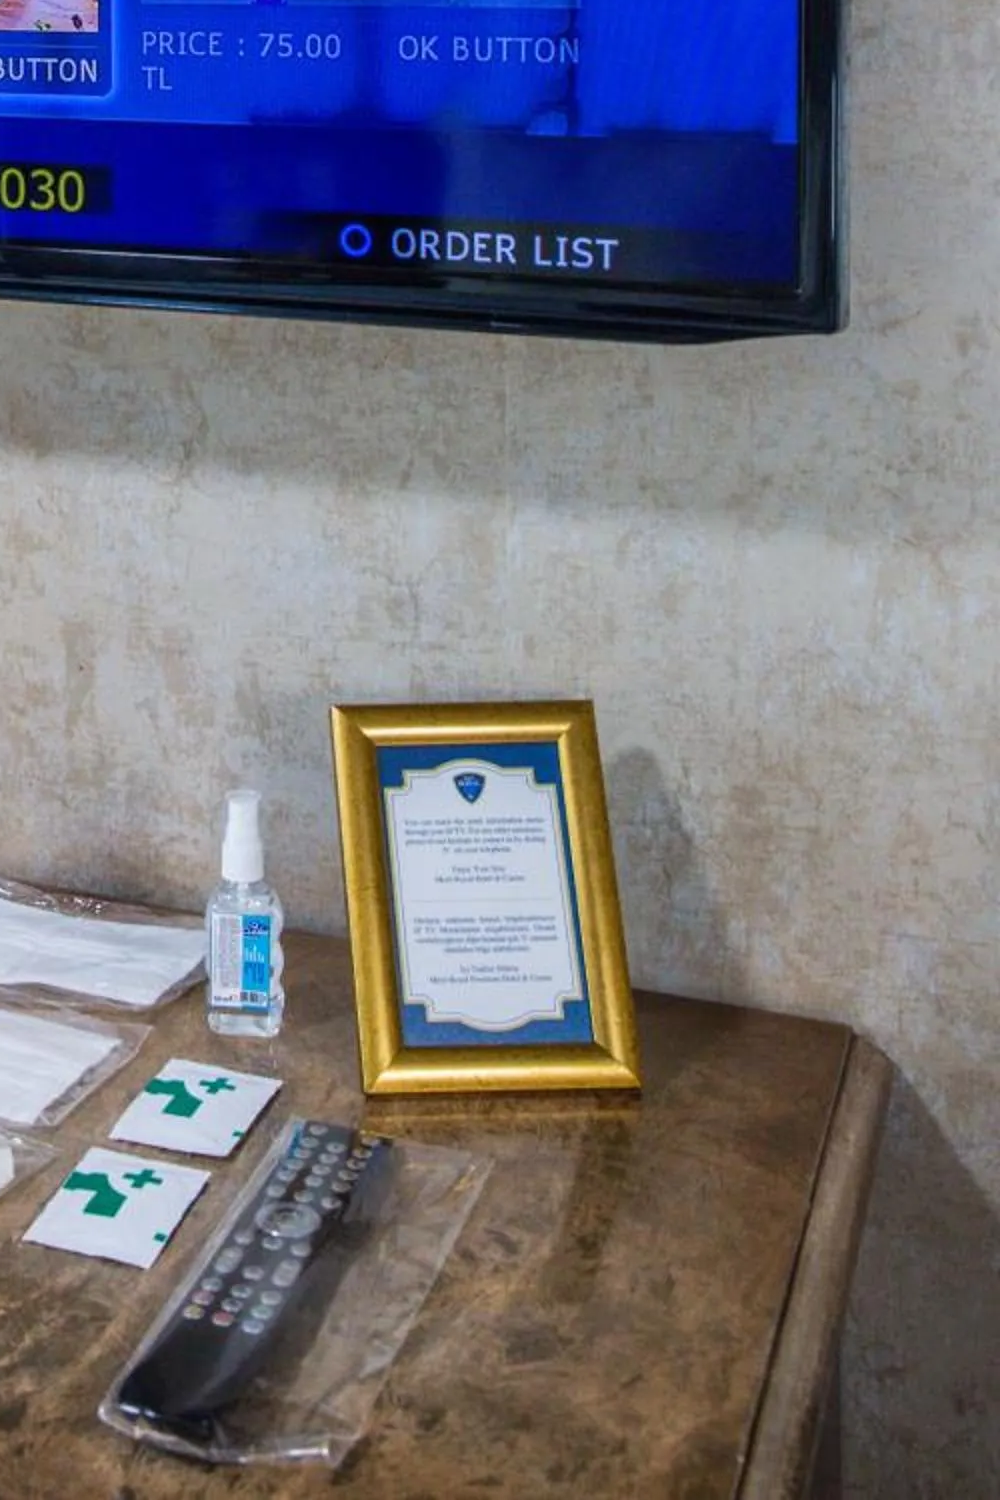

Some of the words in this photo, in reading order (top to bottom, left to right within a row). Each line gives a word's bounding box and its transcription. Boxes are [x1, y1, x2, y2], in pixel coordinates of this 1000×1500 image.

[141, 31, 224, 57] PRICE
[258, 33, 342, 59] 75.00
[398, 35, 439, 61] OK
[453, 37, 580, 64] BUTTON
[141, 66, 173, 91] TL
[391, 227, 517, 265] ORDER
[534, 235, 620, 271] LIST
